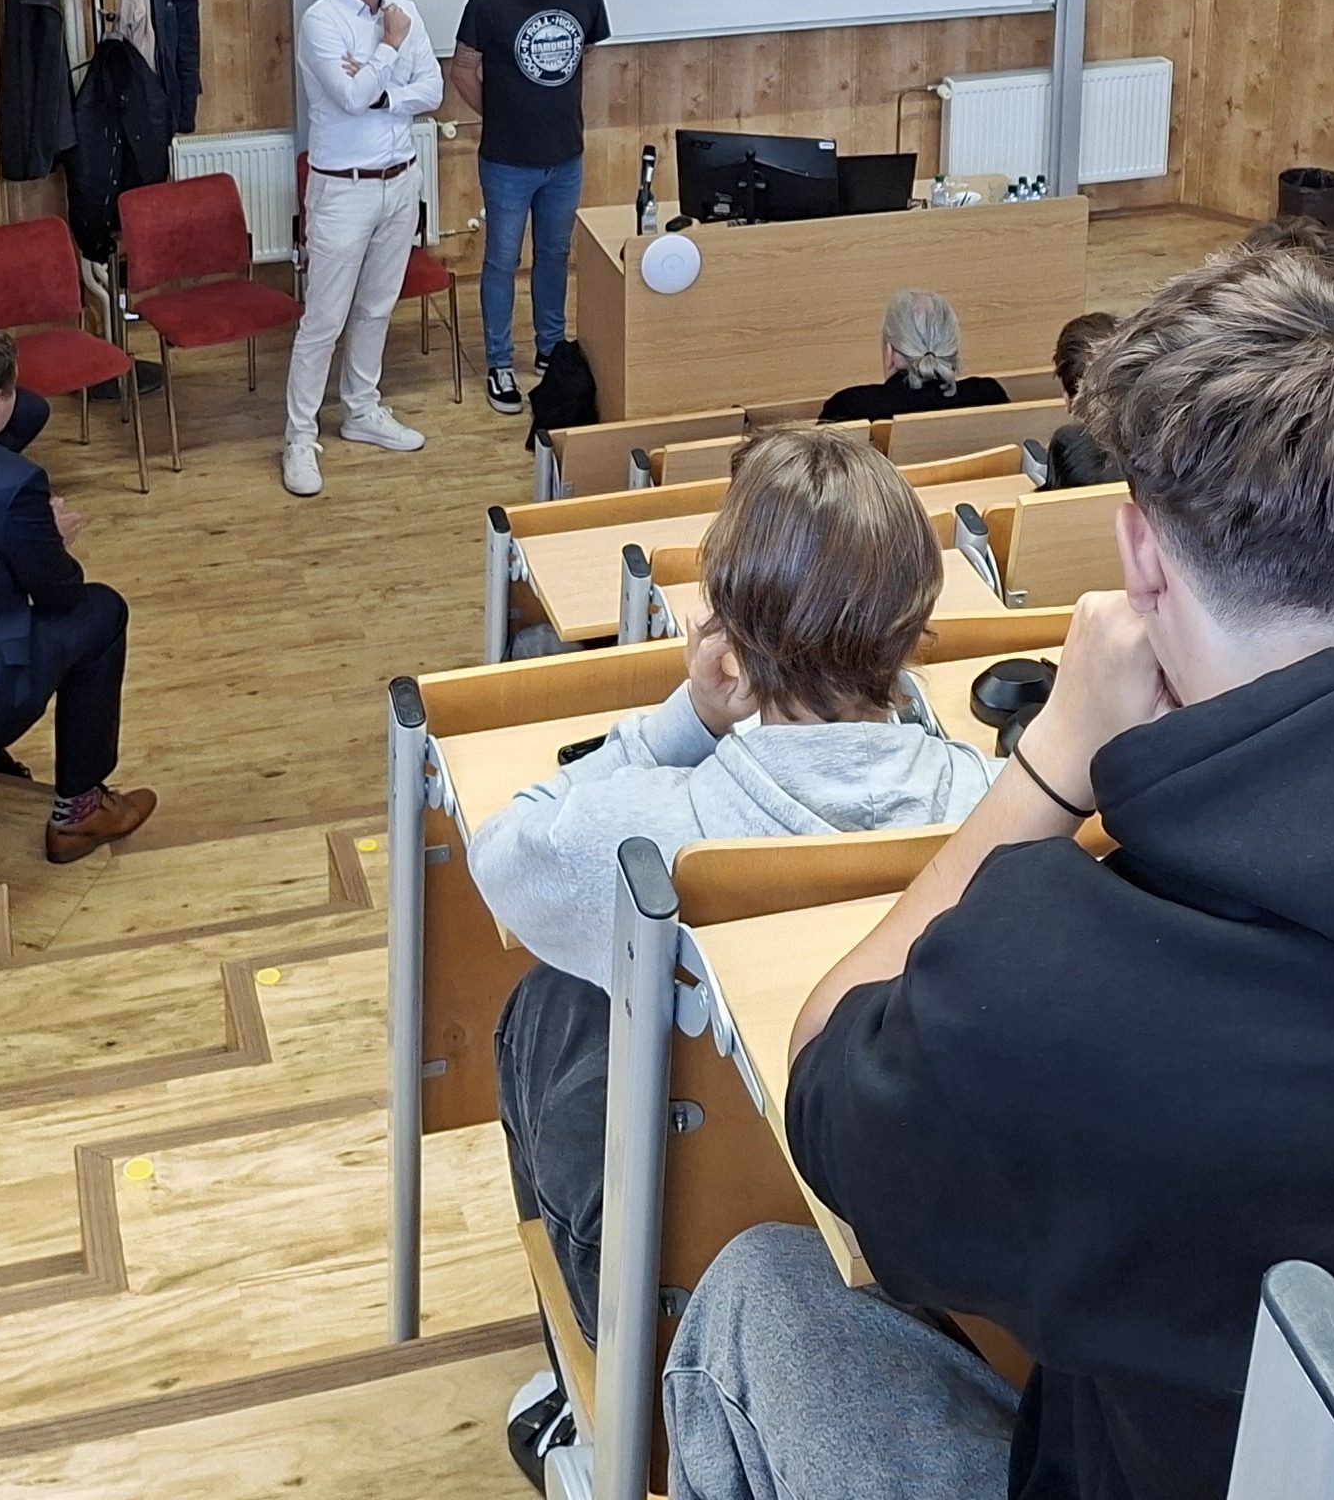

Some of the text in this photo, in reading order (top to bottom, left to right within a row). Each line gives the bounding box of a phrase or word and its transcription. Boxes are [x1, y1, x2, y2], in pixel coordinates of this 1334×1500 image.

[526, 16, 551, 37] ROLL
[555, 16, 577, 35] HIGH
[521, 51, 543, 78] ROCK
